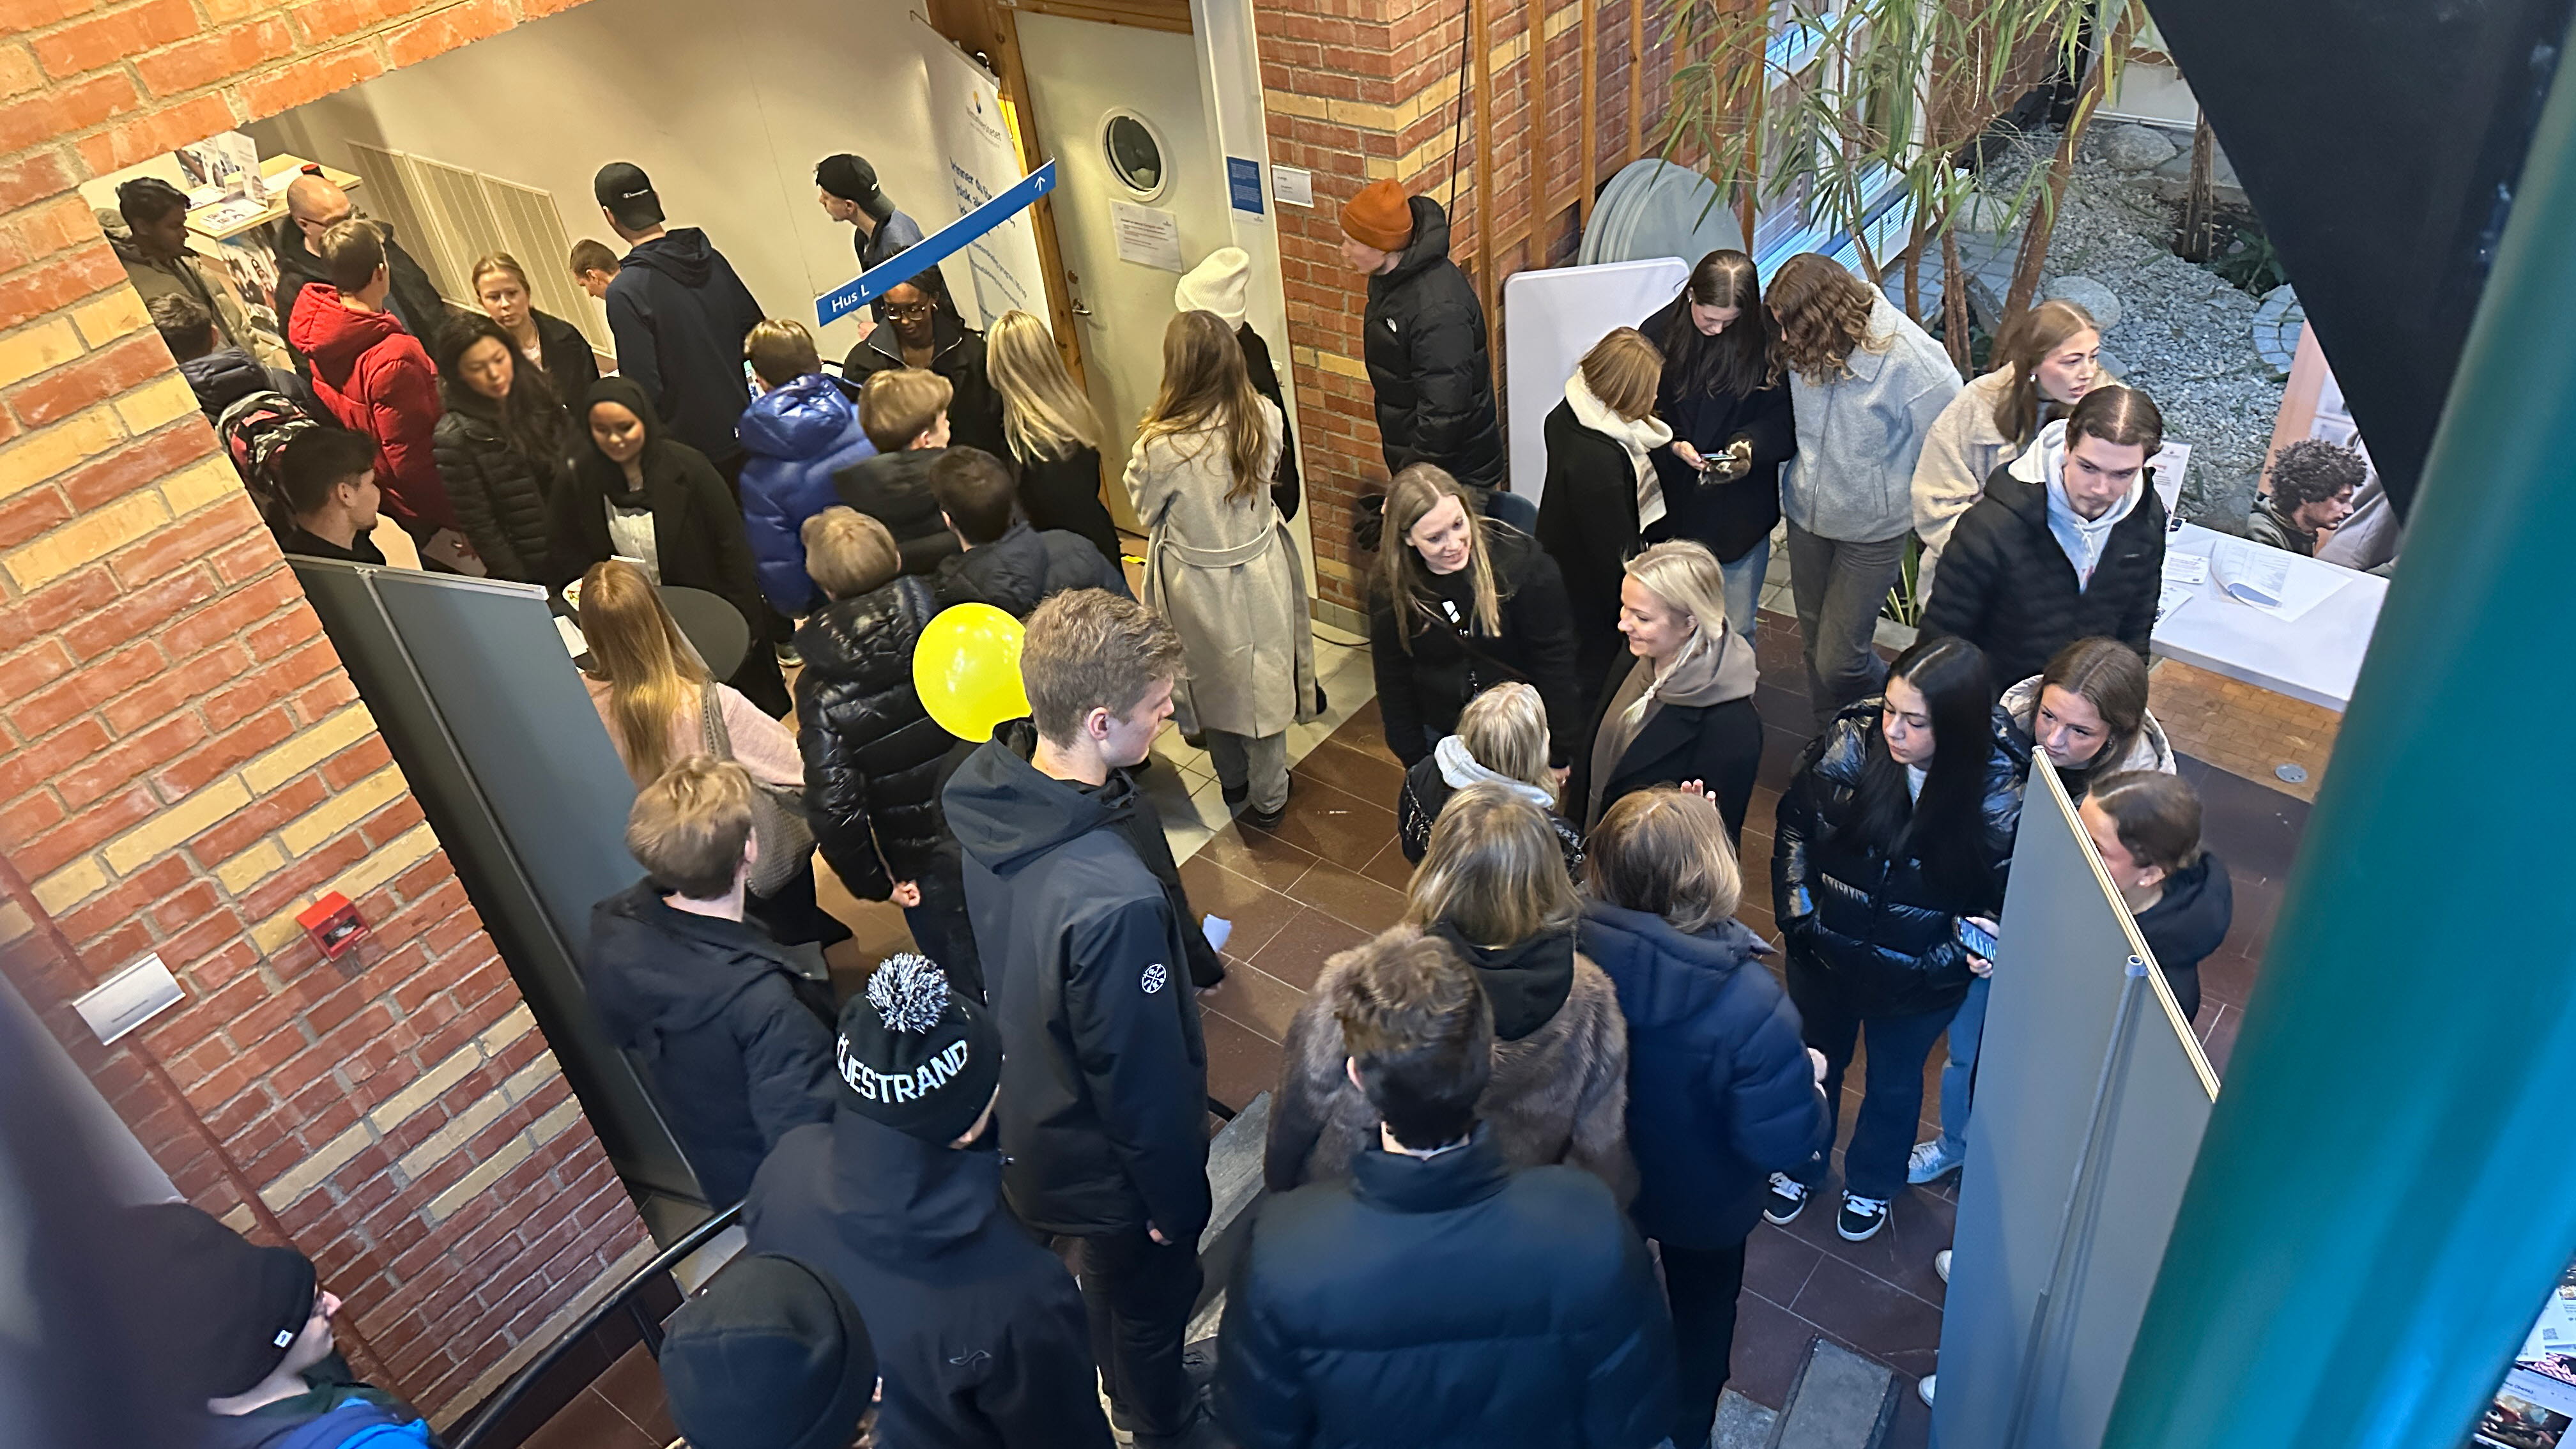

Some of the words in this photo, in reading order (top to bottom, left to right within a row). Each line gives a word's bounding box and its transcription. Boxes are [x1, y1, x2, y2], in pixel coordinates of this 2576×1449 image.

[832, 292, 857, 312] Hus
[861, 284, 870, 297] L
[836, 1032, 967, 1103] ÖJESTRAND
